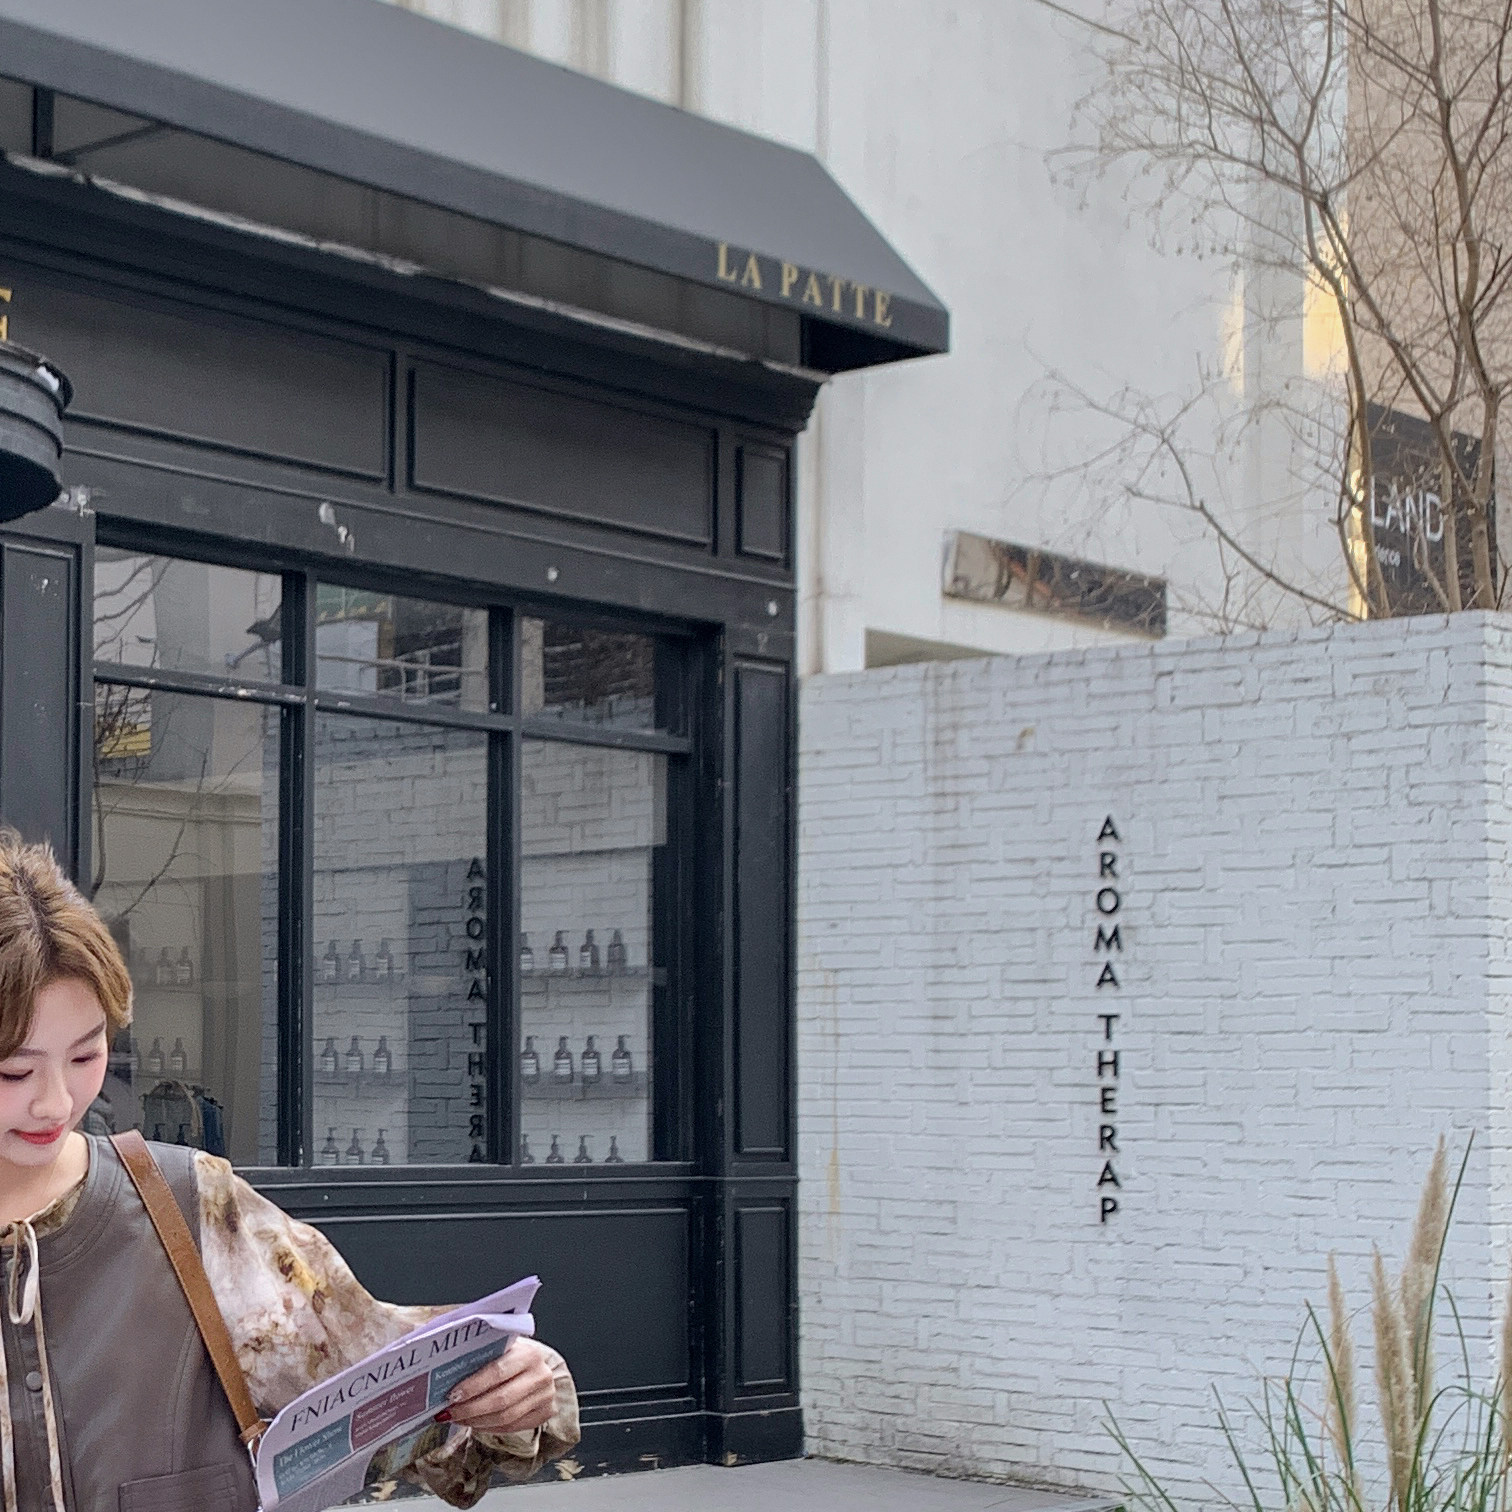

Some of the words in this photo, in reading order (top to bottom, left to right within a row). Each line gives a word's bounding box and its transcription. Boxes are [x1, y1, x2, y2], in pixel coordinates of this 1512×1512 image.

[717, 243, 762, 289] LA
[781, 263, 892, 327] PATTE
[1371, 475, 1445, 543] LAND
[1094, 814, 1123, 990] AROMA
[1096, 1013, 1121, 1224] THERAP
